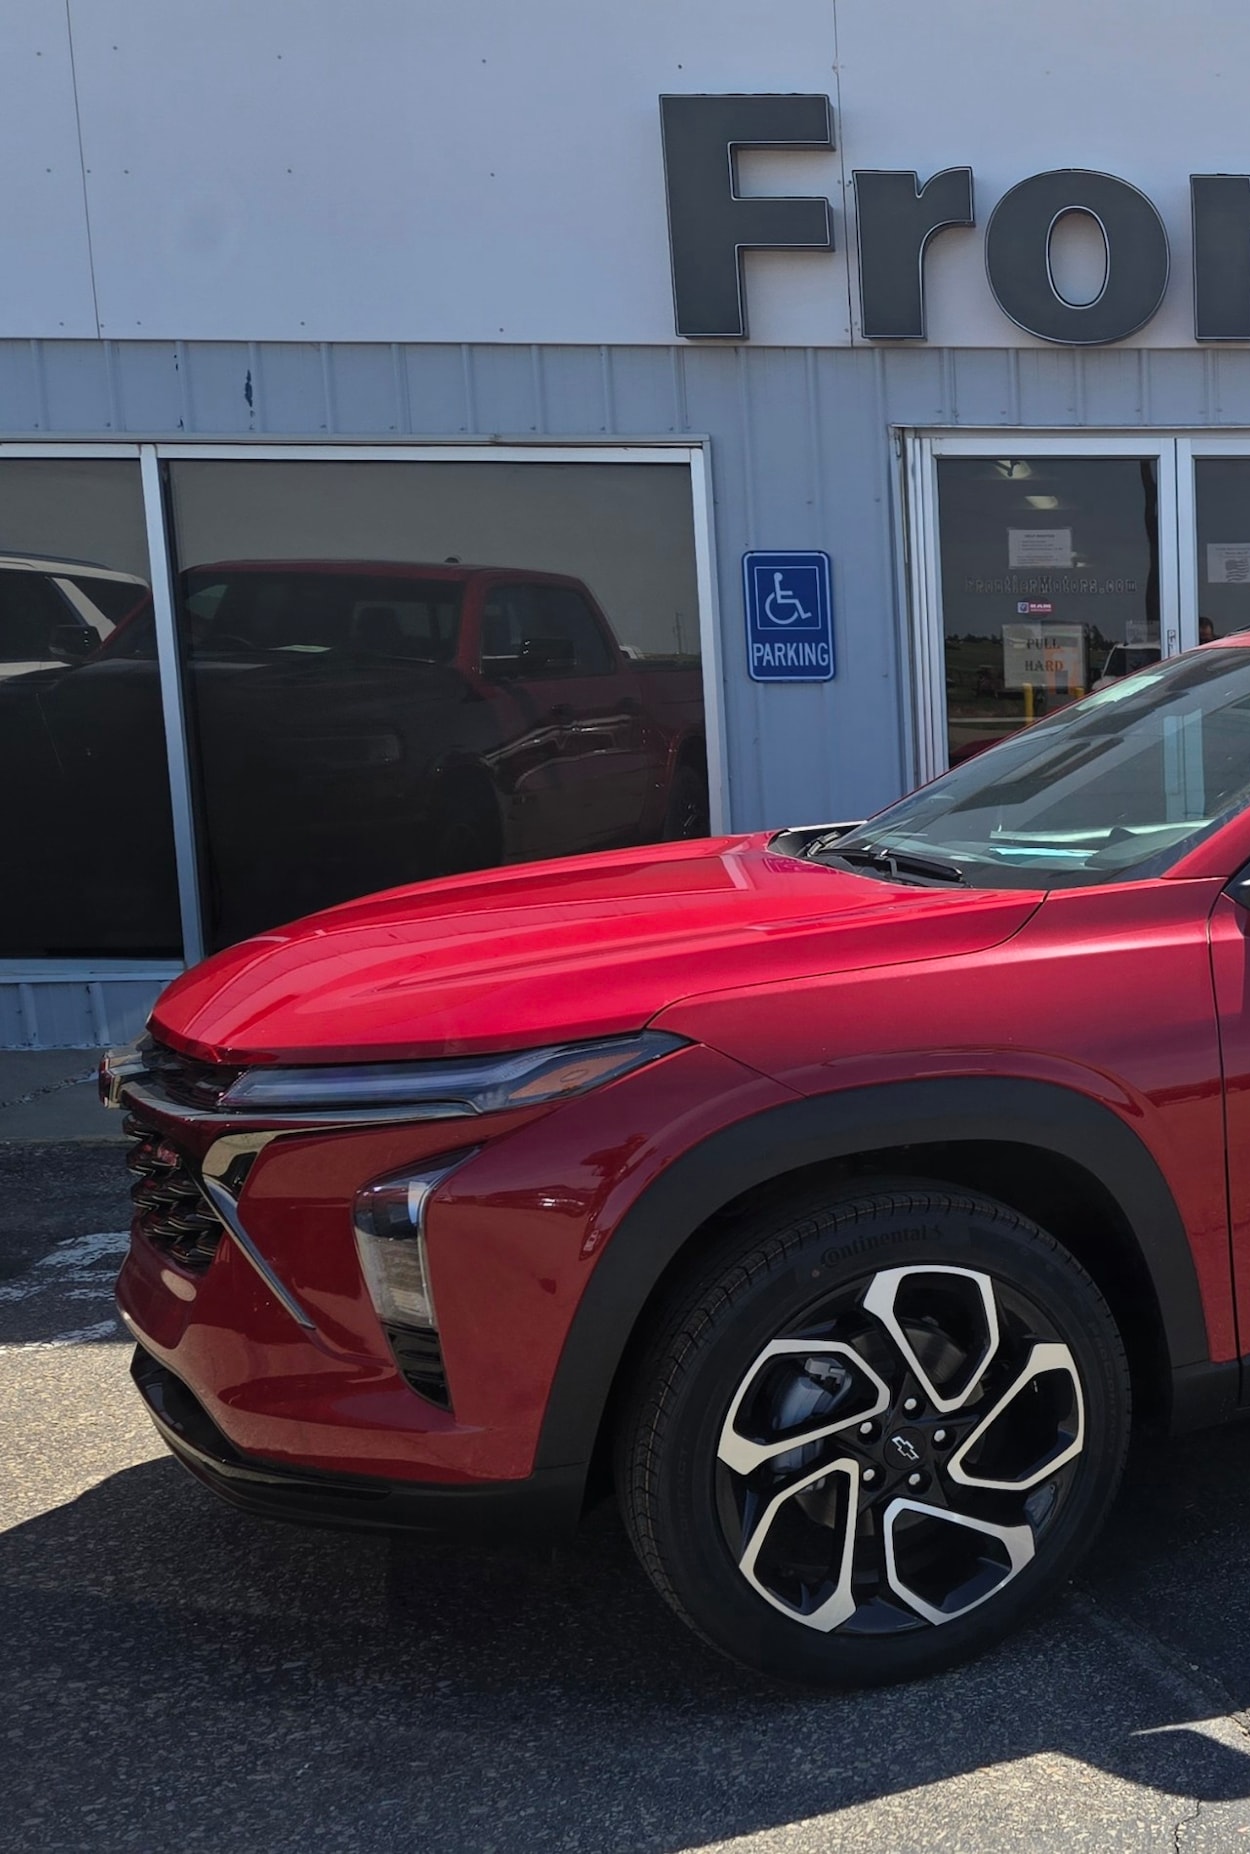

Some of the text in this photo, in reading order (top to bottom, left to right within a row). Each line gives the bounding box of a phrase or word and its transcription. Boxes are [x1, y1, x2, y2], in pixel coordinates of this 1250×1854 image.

[1026, 638, 1060, 650] PULL
[753, 643, 829, 666] PARKING
[1024, 660, 1064, 672] HARD
[820, 1224, 928, 1268] Continental
